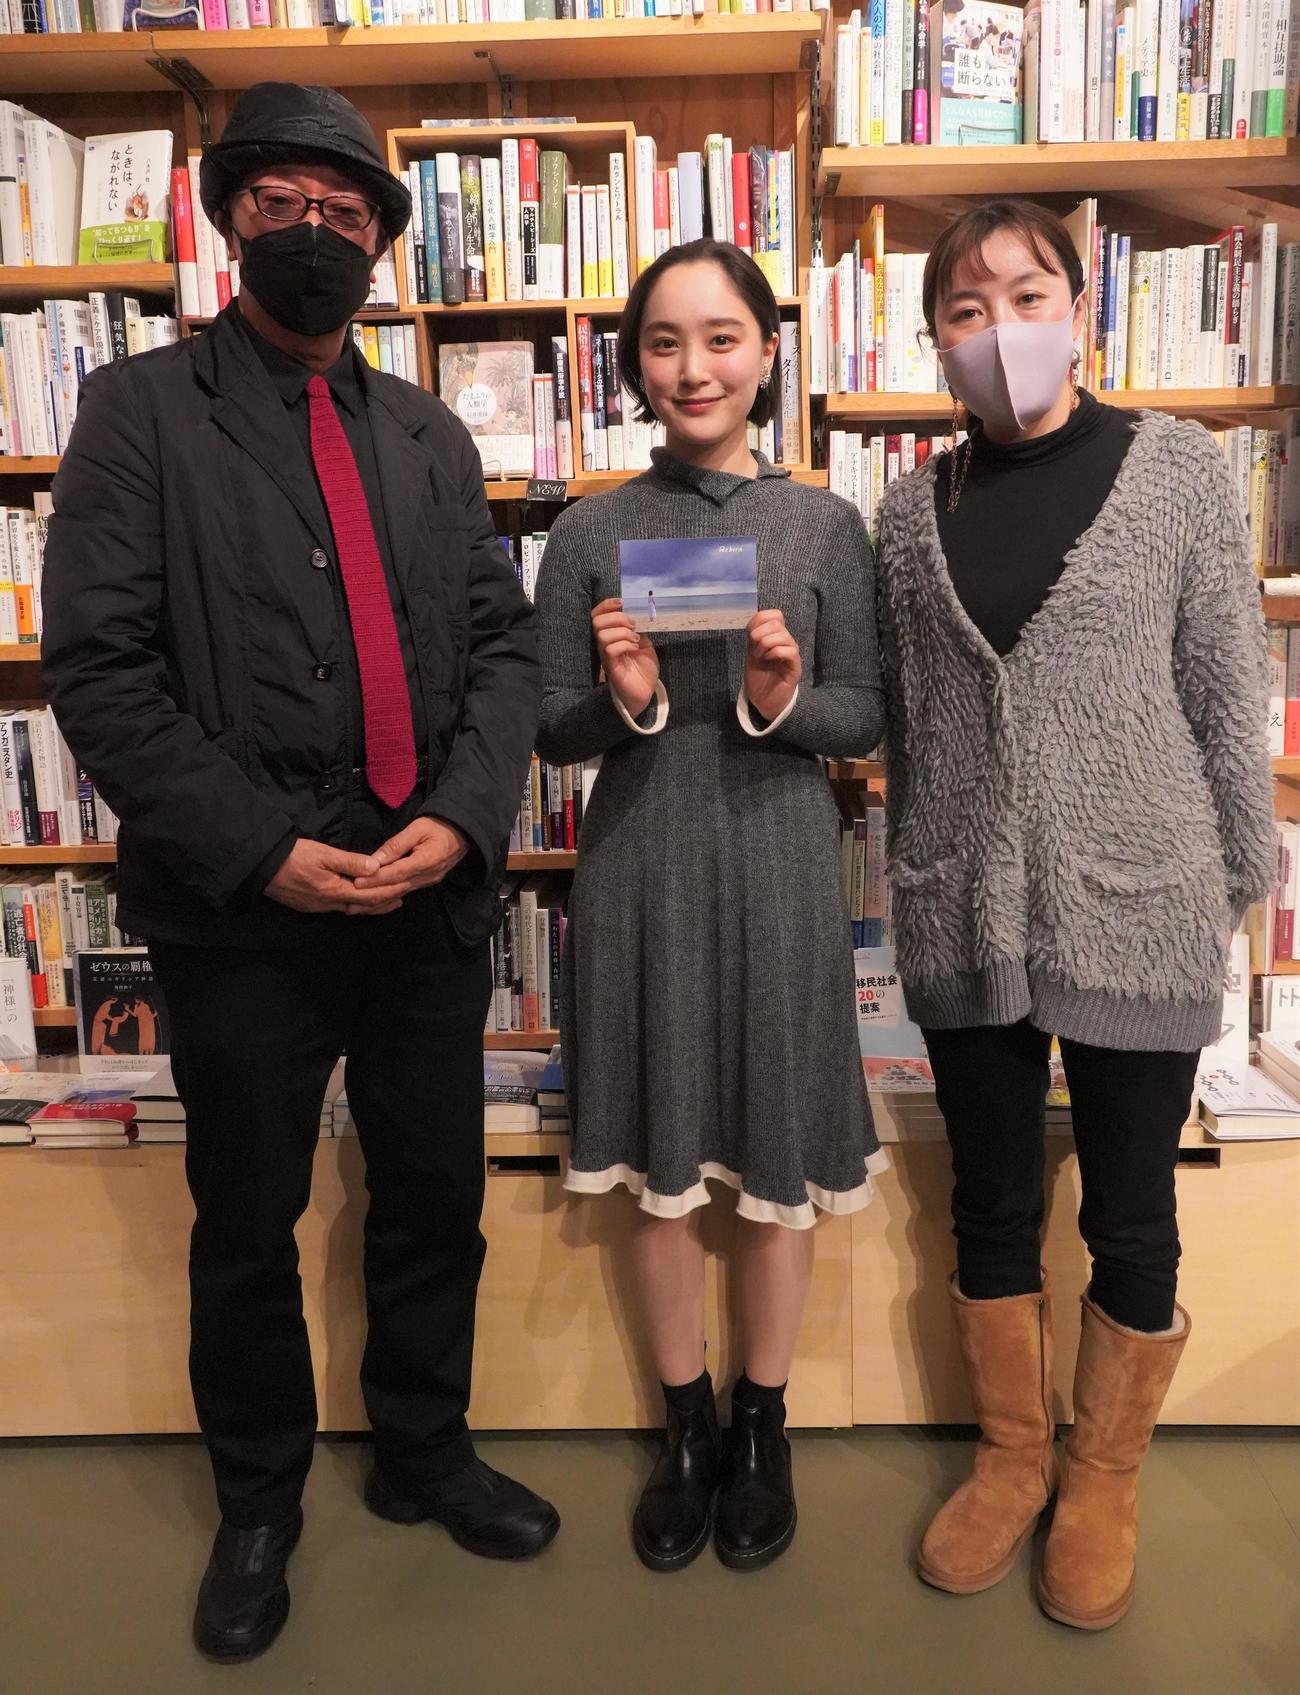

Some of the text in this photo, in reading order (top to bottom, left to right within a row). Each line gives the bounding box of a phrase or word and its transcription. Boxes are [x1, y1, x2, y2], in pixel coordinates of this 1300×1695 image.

[958, 52, 982, 69] 誰も
[957, 70, 1006, 87] 断らない
[123, 144, 133, 186] ときは、
[108, 149, 120, 211] ながれない
[488, 198, 498, 255] 文化人類学入門
[113, 321, 125, 359] 狂気な
[783, 358, 793, 419] タイトな文化
[465, 400, 487, 409] 人類学
[529, 483, 566, 498] NEW
[1270, 712, 1283, 727] え
[0, 721, 14, 780] アフガニスタン史
[14, 810, 23, 833] タリバン
[94, 898, 103, 945] アメリカと
[90, 960, 154, 973] ゼウスの覇権
[856, 974, 897, 990] 移民社会
[858, 989, 885, 1002] 20の
[860, 1002, 880, 1015] 提案
